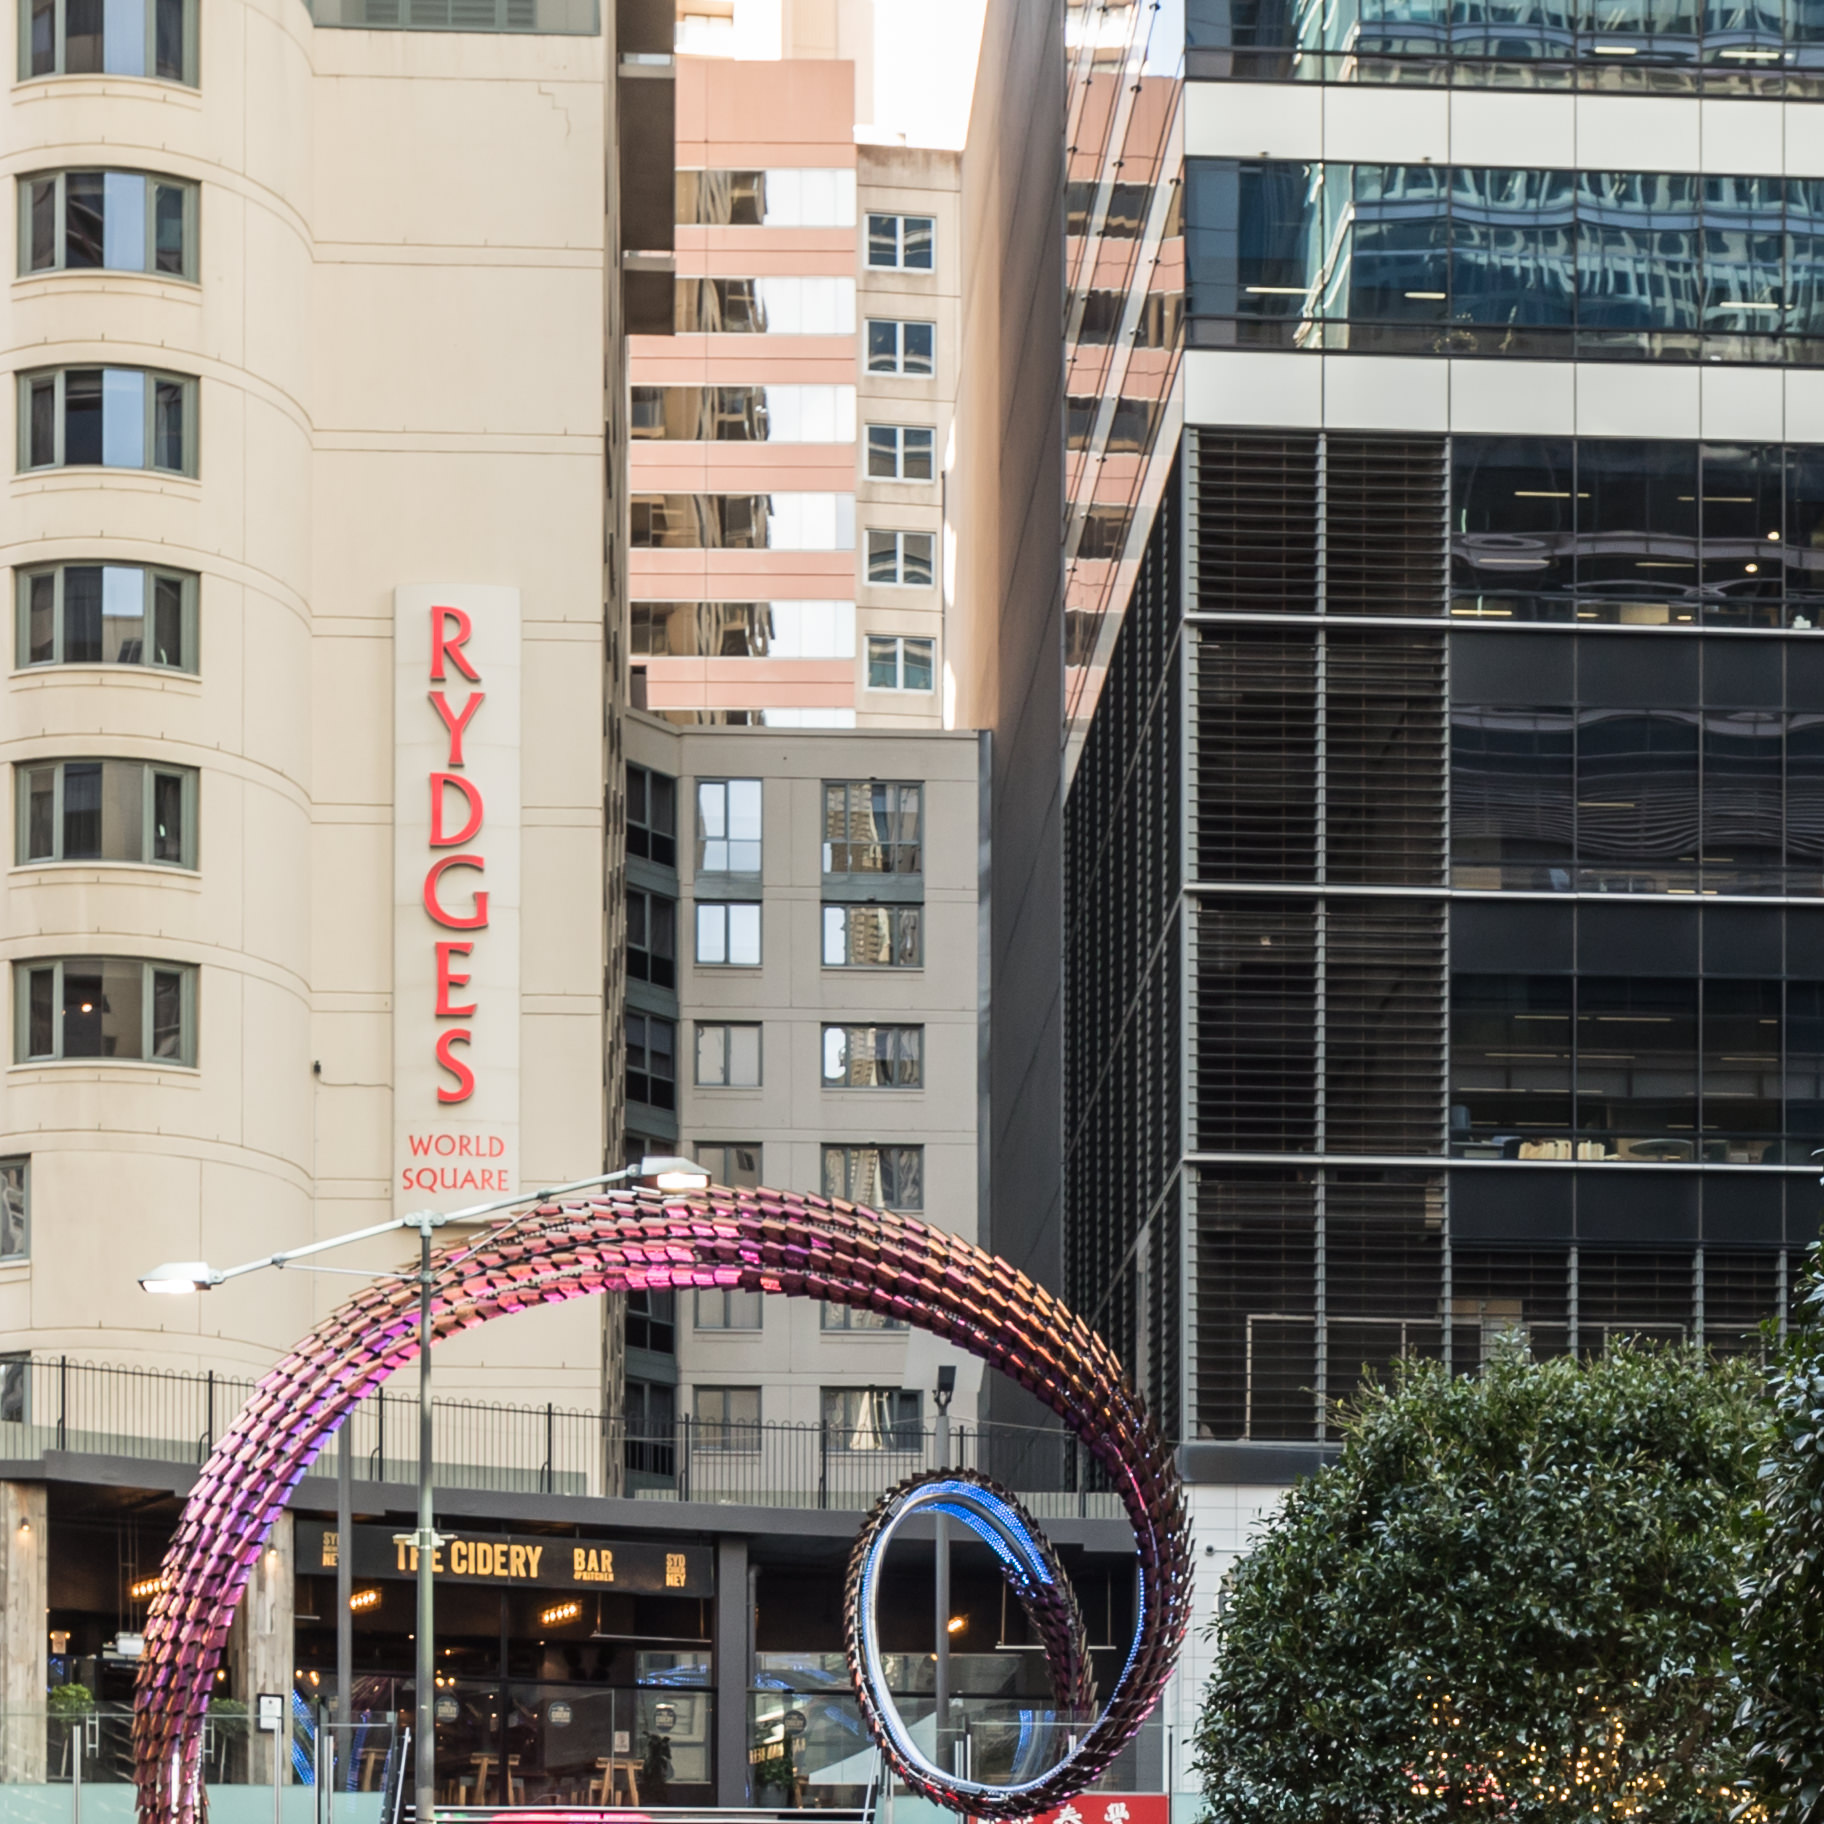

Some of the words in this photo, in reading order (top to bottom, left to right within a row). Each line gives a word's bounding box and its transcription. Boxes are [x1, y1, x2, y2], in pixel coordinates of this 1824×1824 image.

[422, 604, 490, 1104] RYDGES
[409, 1133, 505, 1159] WORLD
[402, 1166, 510, 1192] SQUARE
[450, 1540, 543, 1579] CIDERY
[573, 1548, 614, 1573] BAR
[666, 1553, 687, 1567] SYD
[666, 1573, 687, 1587] NEY
